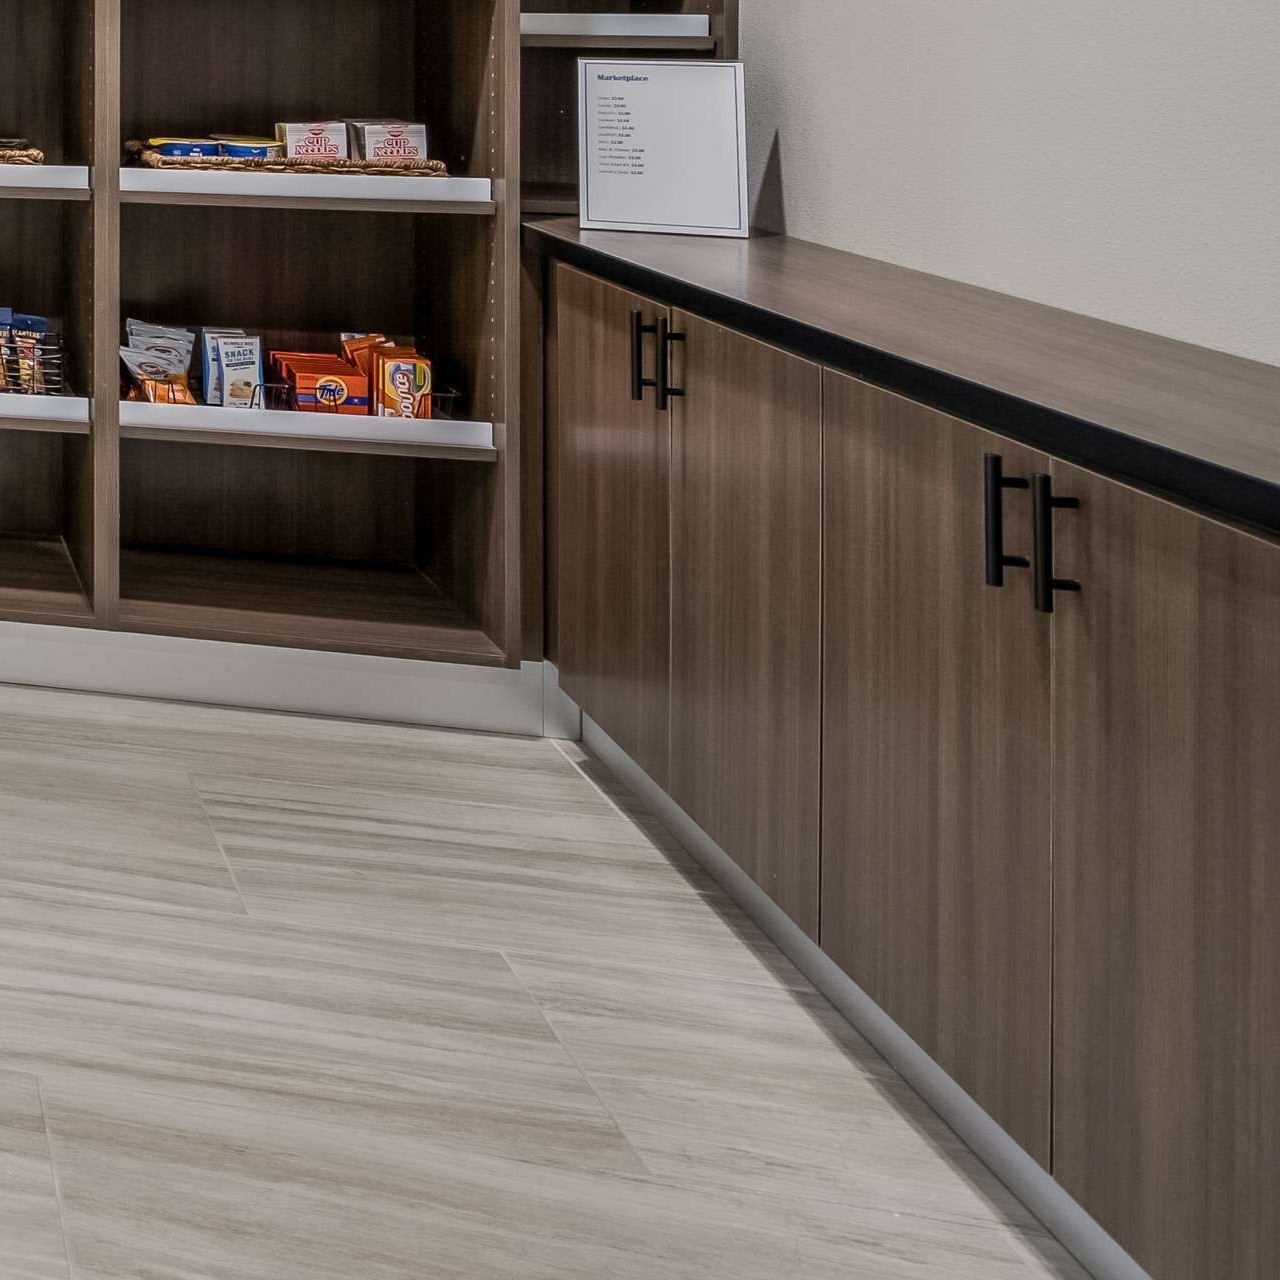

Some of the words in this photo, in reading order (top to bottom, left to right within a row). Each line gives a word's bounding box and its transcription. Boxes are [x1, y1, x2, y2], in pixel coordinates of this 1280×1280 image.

[596, 74, 649, 82] Marketplace
[305, 137, 329, 148] CUP
[383, 139, 408, 151] CUP
[294, 145, 339, 157] NOODLES
[372, 147, 418, 160] NOODLES
[224, 348, 254, 359] SNACK
